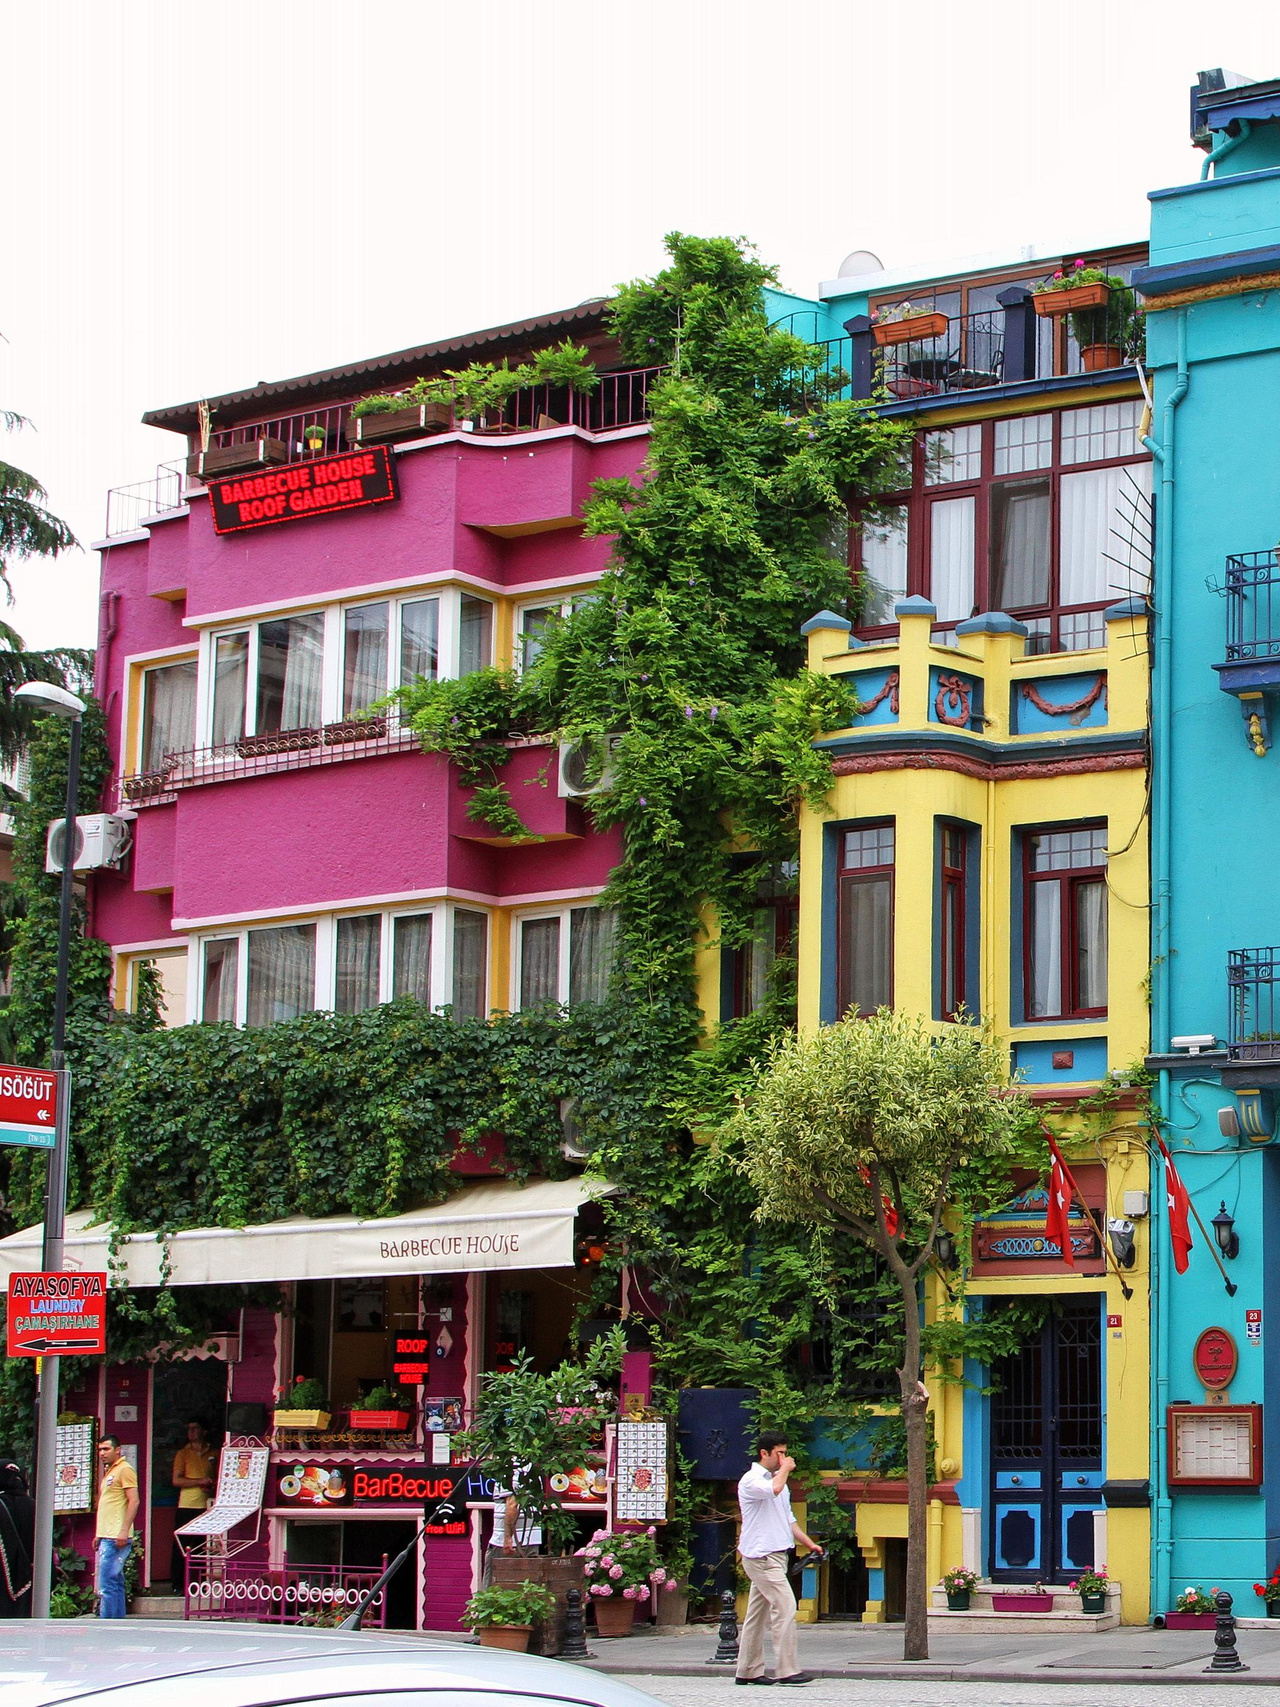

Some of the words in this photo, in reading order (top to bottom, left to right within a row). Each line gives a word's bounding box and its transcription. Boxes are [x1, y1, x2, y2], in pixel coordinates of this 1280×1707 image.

[220, 468, 312, 504] BARBECUE
[313, 454, 377, 486] HOUSE
[238, 494, 288, 522] ROOF
[289, 479, 364, 512] GARDEN
[380, 1236, 462, 1258] BARBECUE
[466, 1233, 519, 1256] HOUSE
[12, 1277, 102, 1298] AYASOFYA
[30, 1300, 85, 1314] LAUNDRY
[1249, 1312, 1258, 1320] 23
[15, 1315, 100, 1334] ÇAMAŞIRHANE
[1110, 1317, 1118, 1325] 21
[396, 1339, 428, 1353] ROOF
[353, 1473, 453, 1498] BarBecue
